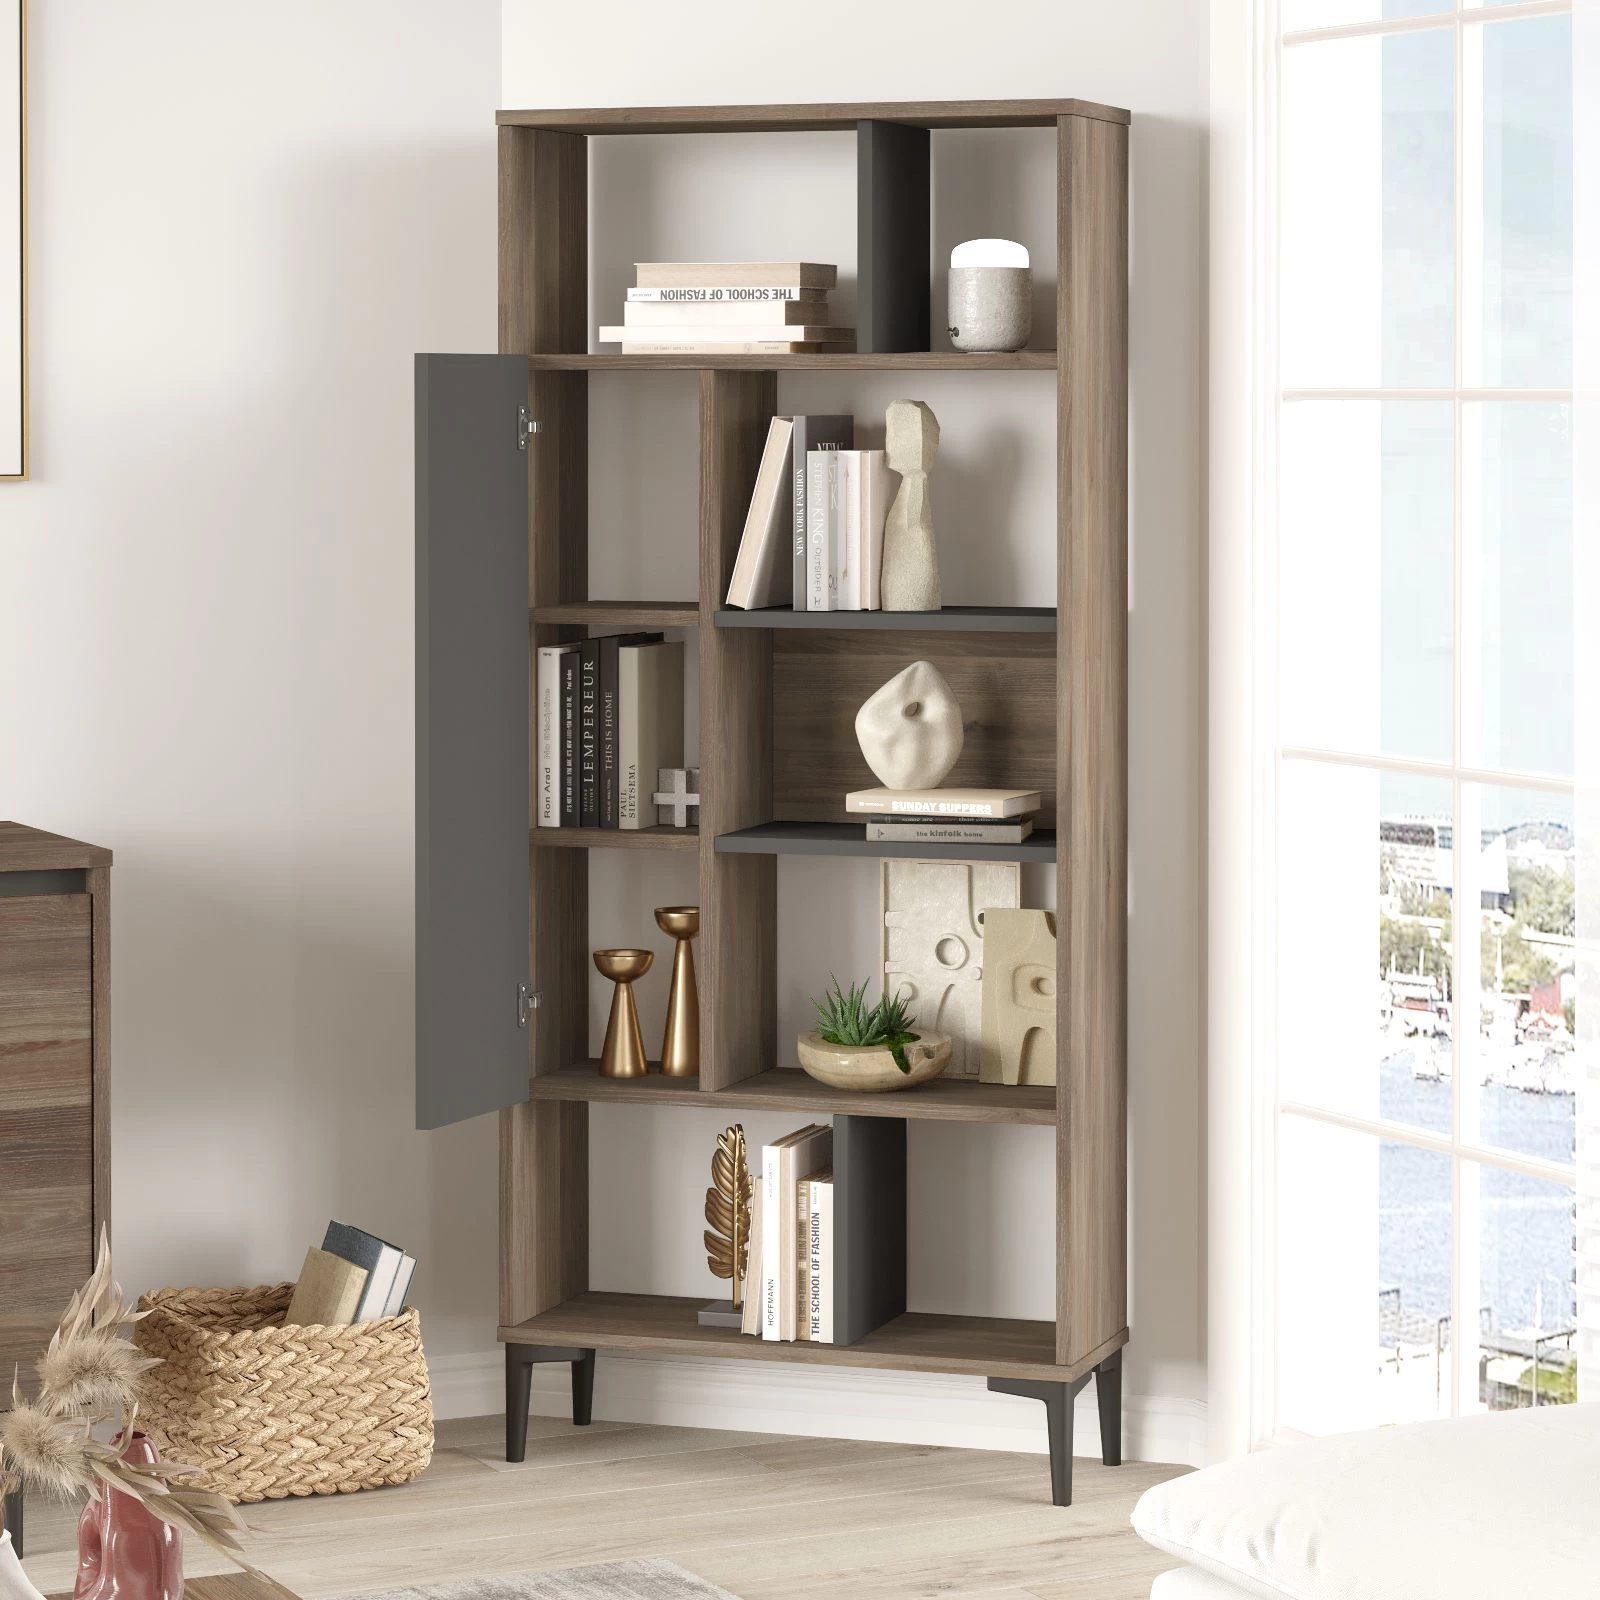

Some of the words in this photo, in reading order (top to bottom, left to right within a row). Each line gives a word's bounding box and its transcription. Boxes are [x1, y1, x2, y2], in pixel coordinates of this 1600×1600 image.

[660, 289, 706, 300] FASHION
[709, 289, 723, 300] OF
[726, 289, 769, 300] SCHOOL
[772, 289, 793, 300] THE
[796, 468, 804, 506] FASHION
[796, 509, 804, 533] YORK
[812, 508, 824, 544] KING
[796, 537, 804, 556] NEW
[814, 547, 822, 592] OUTSIDER
[543, 688, 552, 741] Discipline
[605, 692, 613, 727] HOME
[584, 660, 594, 783] LEMPEREUR
[605, 730, 613, 740] IS
[605, 744, 613, 771] THIS
[891, 801, 937, 812] SUNDAY
[938, 803, 992, 814] SUPPERS
[930, 830, 962, 838] kinfolk
[811, 1212, 820, 1255] FASHION
[798, 1240, 807, 1260] POTTER
[811, 1258, 820, 1270] OF
[767, 1278, 775, 1326] HOFFMANN
[811, 1274, 820, 1312] SCHOOL
[811, 1316, 820, 1335] THE
